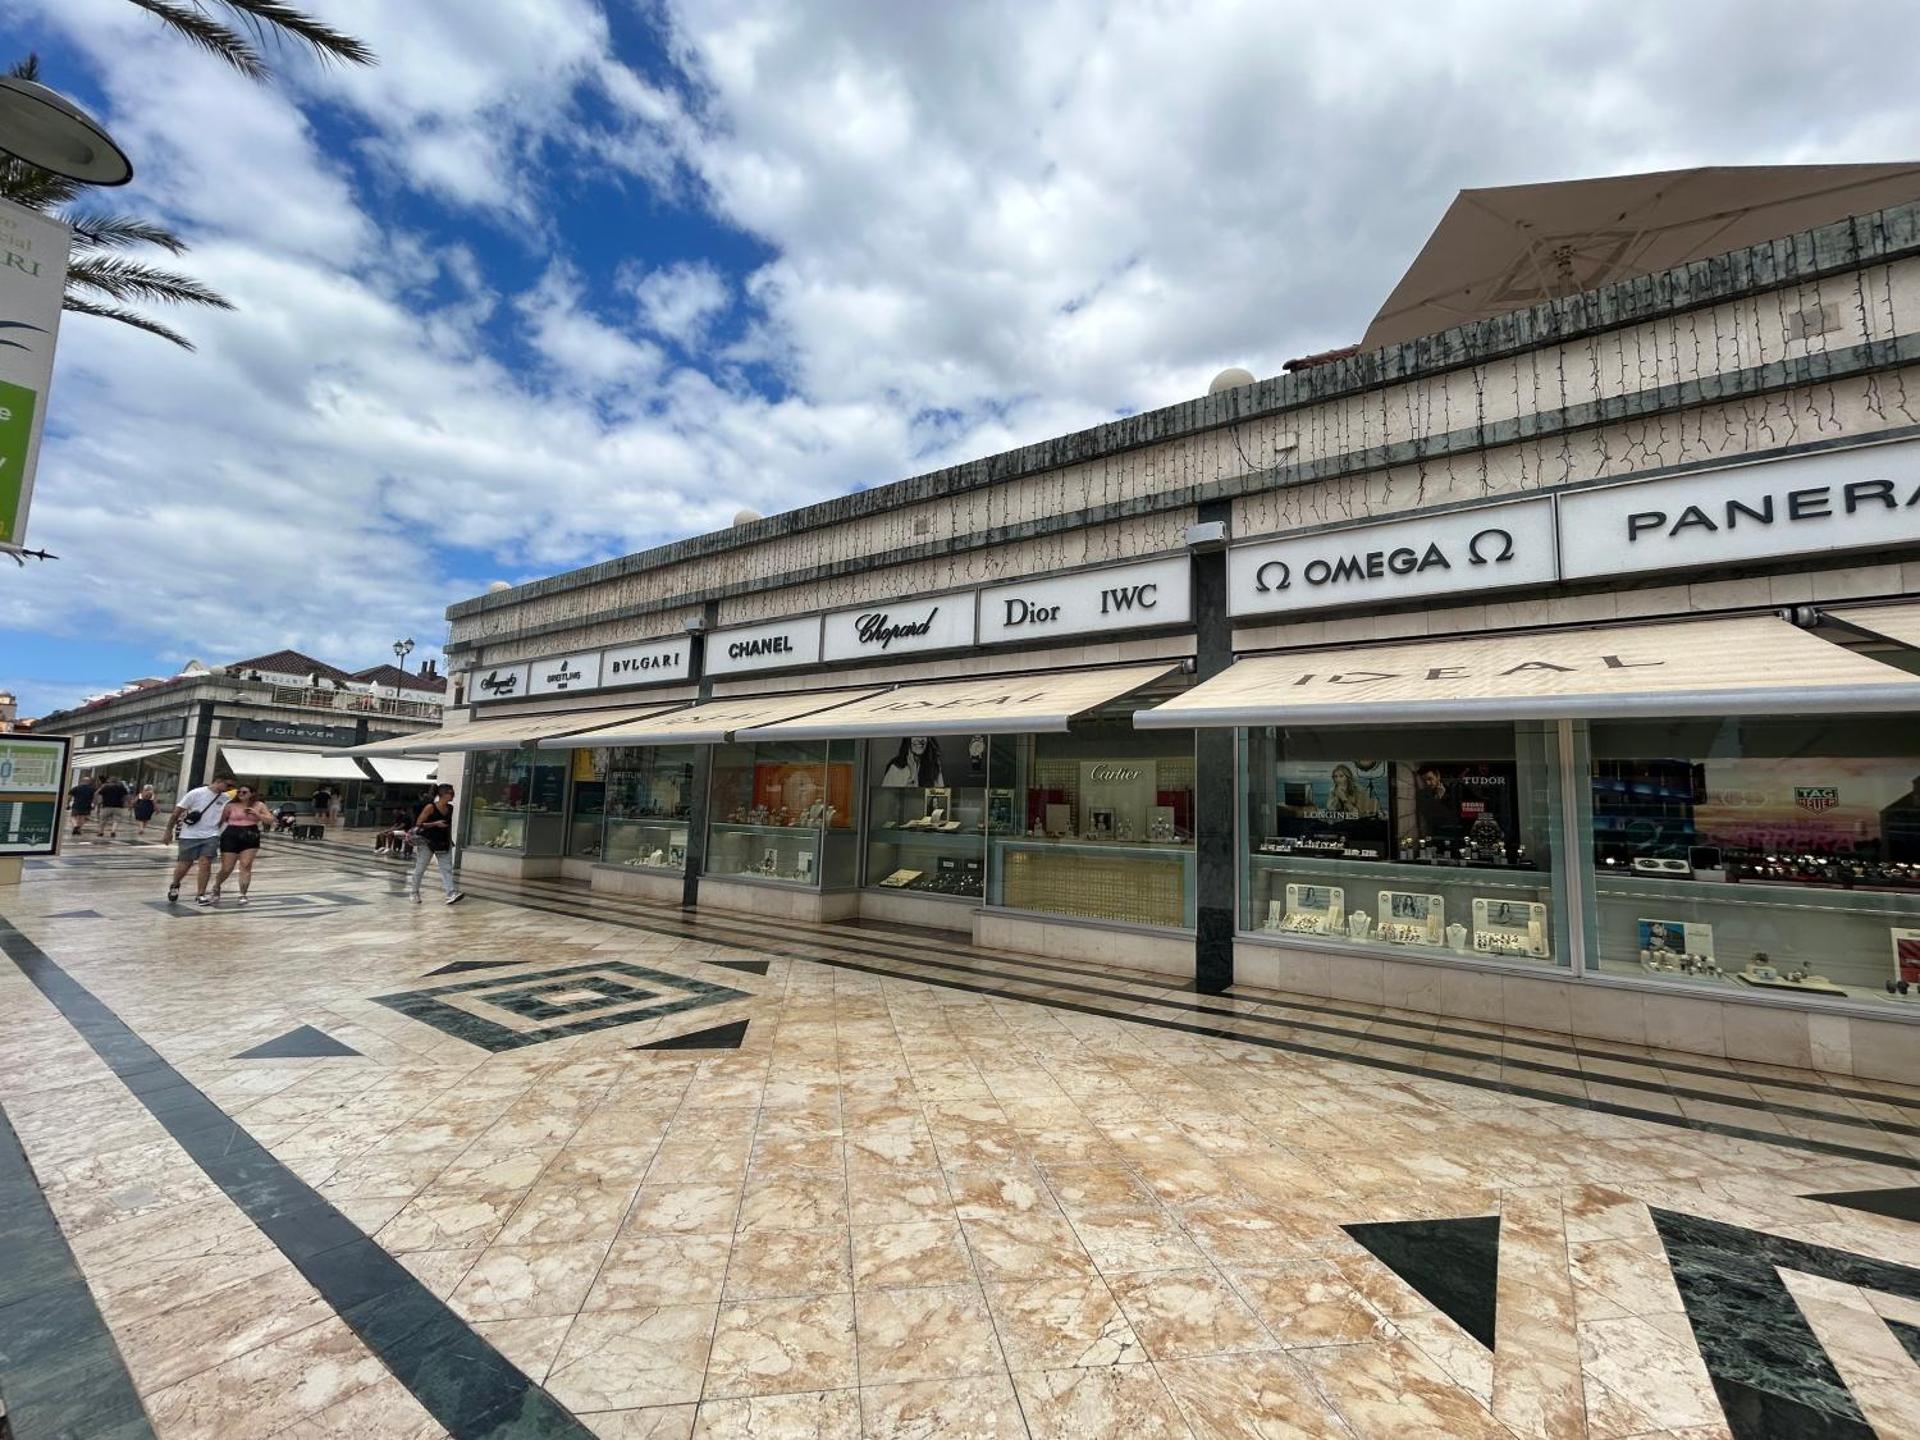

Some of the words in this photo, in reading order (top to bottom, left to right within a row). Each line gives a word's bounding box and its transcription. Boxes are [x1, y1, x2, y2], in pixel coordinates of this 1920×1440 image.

[1627, 479, 1920, 542] PANER
[1304, 542, 1451, 585] OMEGA
[1003, 599, 1061, 627] Dior
[1100, 584, 1158, 613] IWC
[855, 607, 939, 649] Chopard
[728, 636, 793, 658] CHANEL
[613, 653, 680, 673] BVLGARI
[1293, 654, 1664, 686] IDEAL
[1091, 763, 1142, 780] Cartier
[1464, 776, 1506, 785] TUDOR
[1800, 788, 1835, 798] TAG
[1303, 809, 1359, 820] LONGINES
